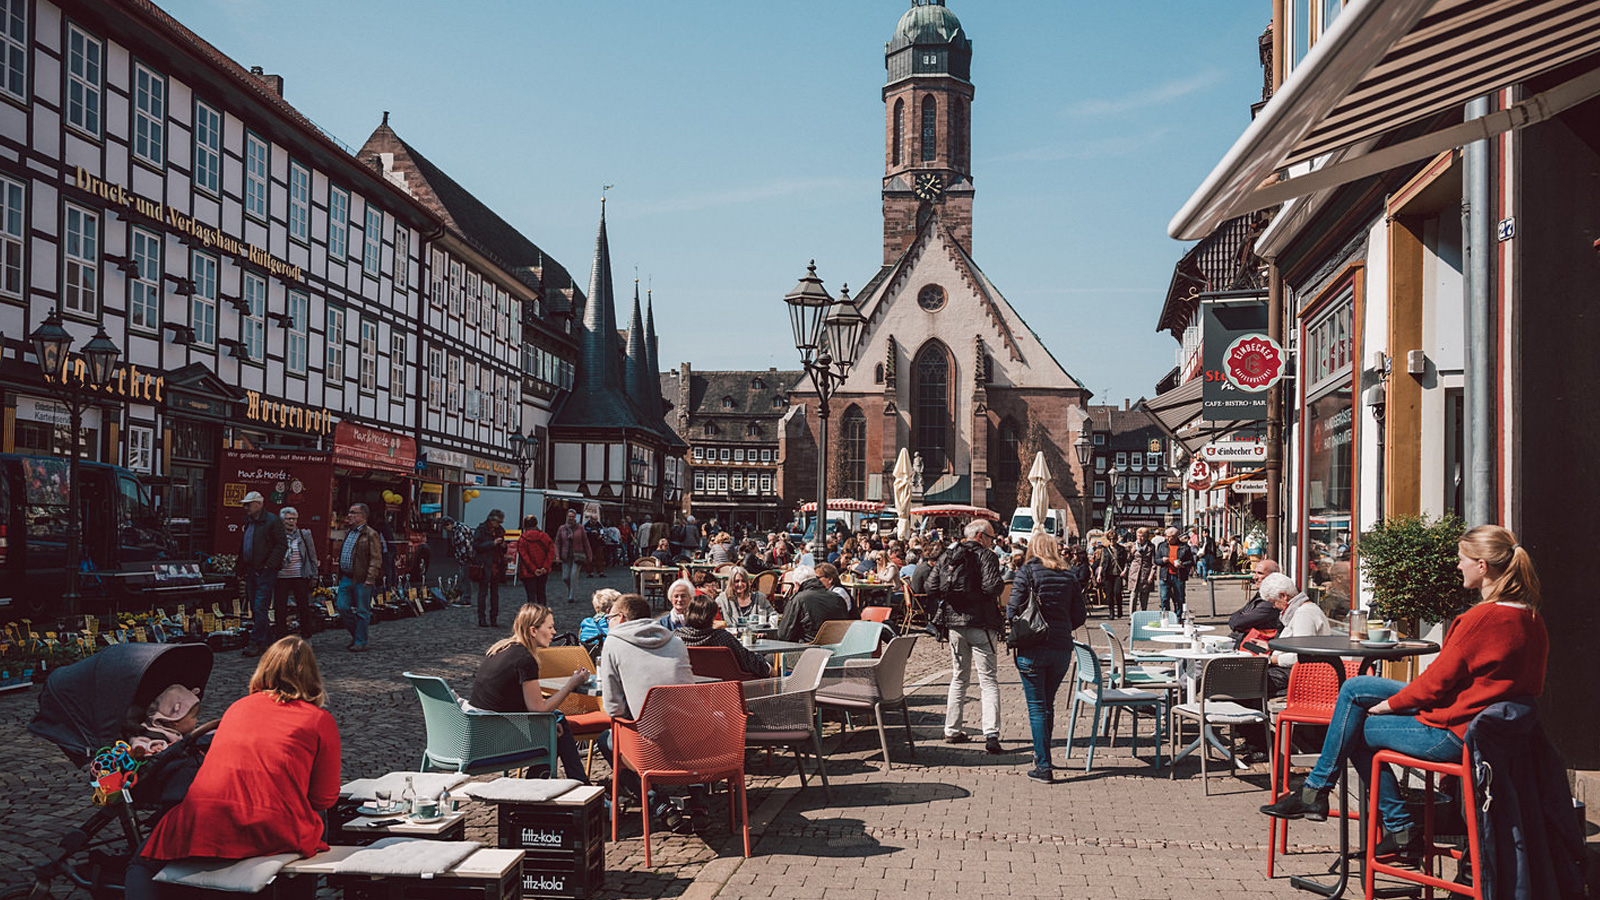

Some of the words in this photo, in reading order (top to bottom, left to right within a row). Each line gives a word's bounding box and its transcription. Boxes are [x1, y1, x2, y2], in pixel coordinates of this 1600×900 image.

[136, 198, 164, 222] und
[167, 205, 243, 255] Verlagshaus
[1233, 343, 1273, 360] EINBECKER
[34, 411, 71, 424] Kartenserv
[1217, 447, 1252, 456] Einbecker
[521, 828, 561, 843] fritz-kola
[523, 875, 564, 891] ritz-kola
